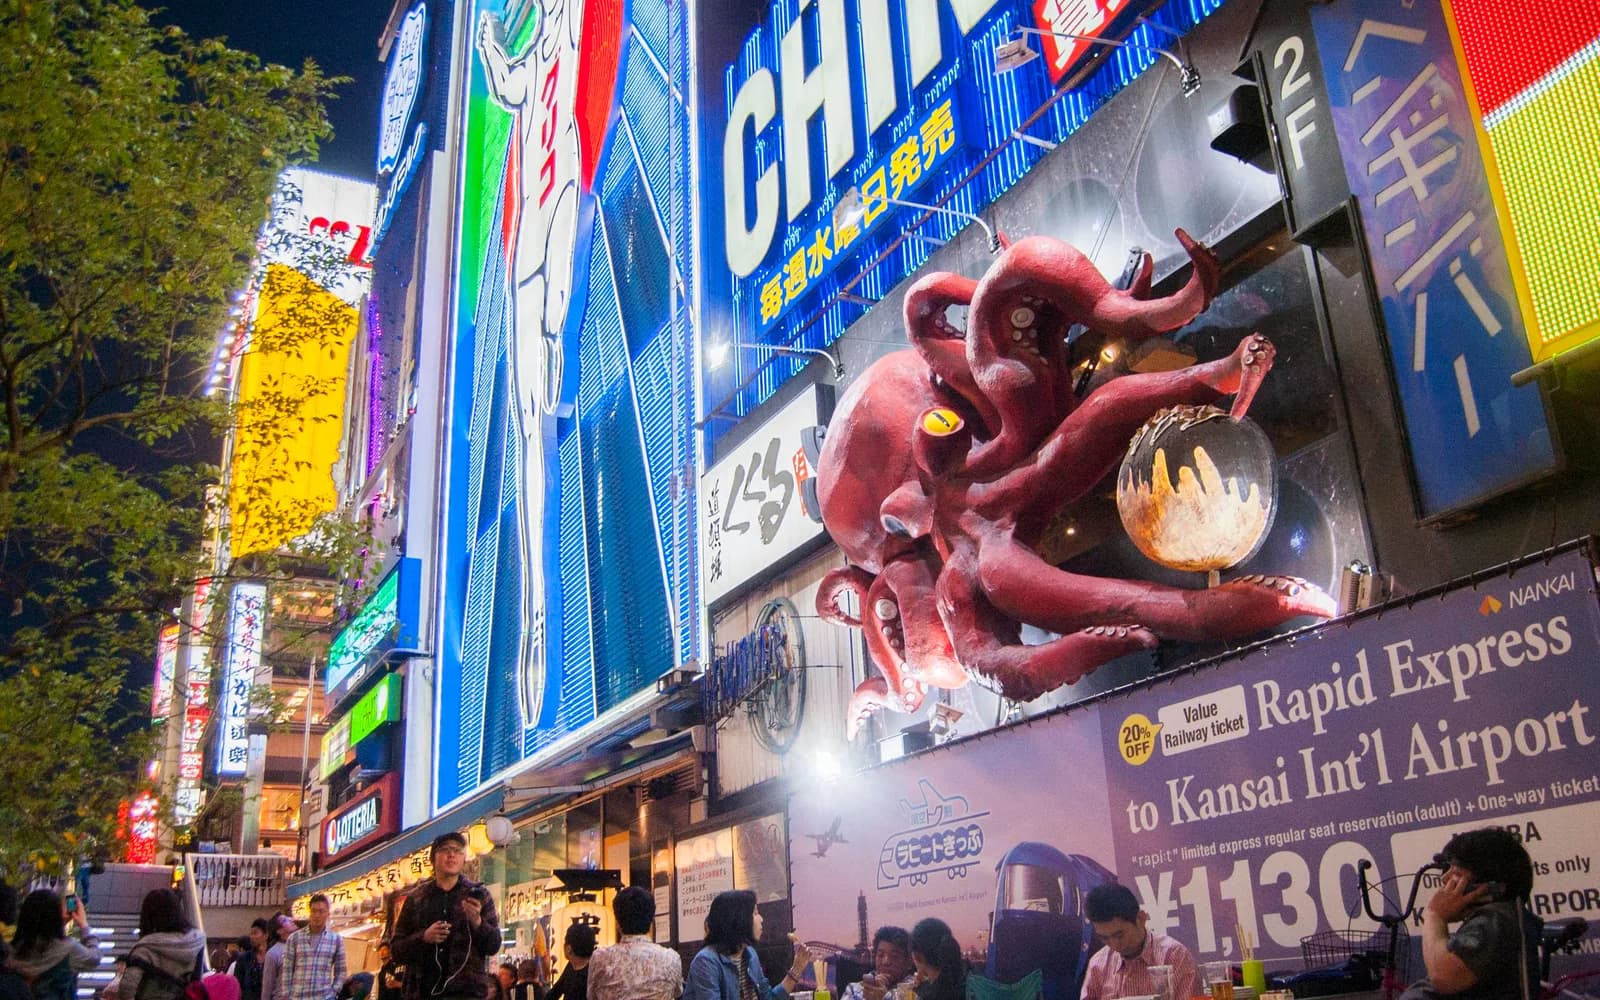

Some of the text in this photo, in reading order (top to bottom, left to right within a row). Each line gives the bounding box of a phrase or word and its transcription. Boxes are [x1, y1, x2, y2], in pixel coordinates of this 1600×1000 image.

[1273, 35, 1316, 170] 2F
[539, 48, 559, 209] グリコ
[1508, 571, 1576, 609] NANKAI
[1252, 615, 1573, 736] Rapid Express
[1122, 724, 1151, 745] 20%
[1164, 714, 1245, 750] Railway ticket
[1183, 703, 1219, 724] Value
[1126, 741, 1151, 759] OFF
[1126, 699, 1596, 834] to Kansai Int'l Airport
[336, 797, 377, 846] LOTTERIA
[1181, 841, 1217, 861] limited
[1219, 836, 1262, 857] express
[1264, 828, 1306, 848] regular
[1309, 823, 1336, 840] seat
[1339, 809, 1413, 834] reservation
[1414, 799, 1461, 823] (adult)
[1478, 787, 1546, 812] One-way
[1549, 775, 1600, 799] ticket
[1555, 855, 1592, 876] only
[1134, 841, 1385, 957] ¥1,130
